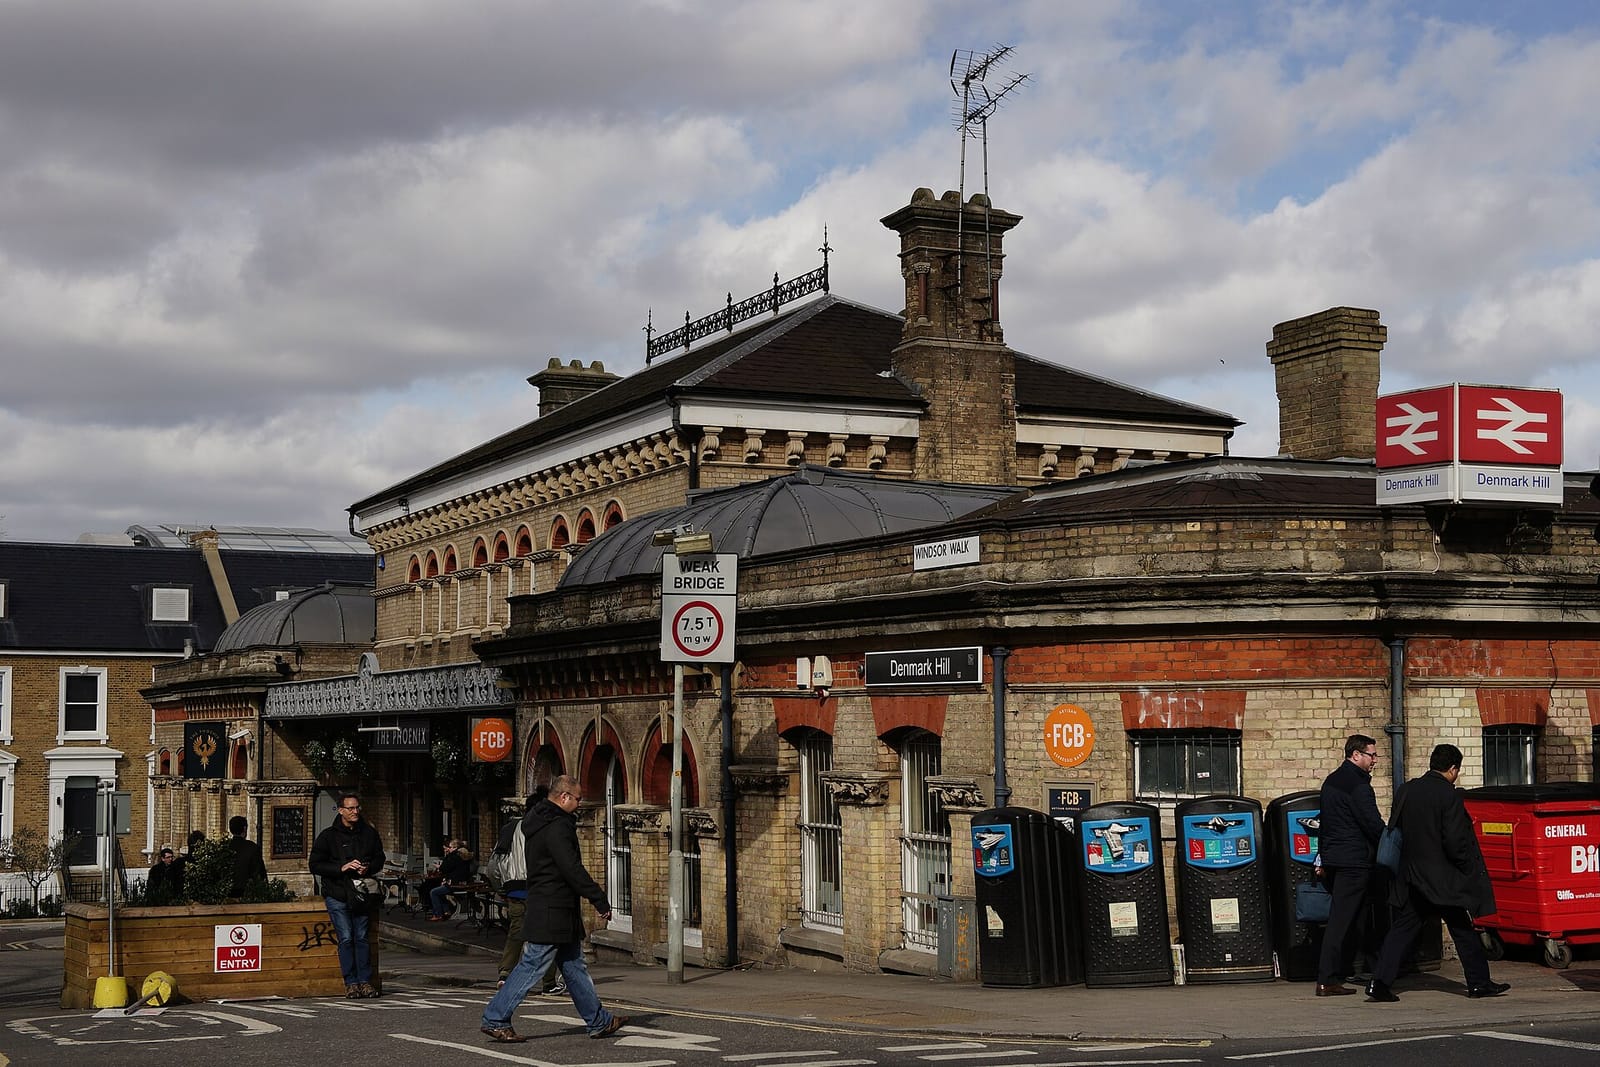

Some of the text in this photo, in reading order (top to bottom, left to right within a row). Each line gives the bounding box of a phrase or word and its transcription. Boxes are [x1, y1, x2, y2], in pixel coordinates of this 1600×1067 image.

[1386, 474, 1439, 490] Denmark Hill
[1477, 473, 1550, 488] Denmark Hill
[915, 540, 970, 560] WINDSOR WALK
[680, 561, 720, 573] WEAK
[674, 577, 725, 589] BRIDGE
[890, 656, 950, 677] Denmark Hill
[392, 727, 426, 745] PHOENIX
[480, 731, 505, 749] FCB
[1053, 723, 1085, 748] FCB
[1061, 791, 1080, 805] FCB
[1545, 824, 1588, 838] GENERAL
[230, 948, 247, 957] NO
[220, 959, 256, 969] ENTRY
